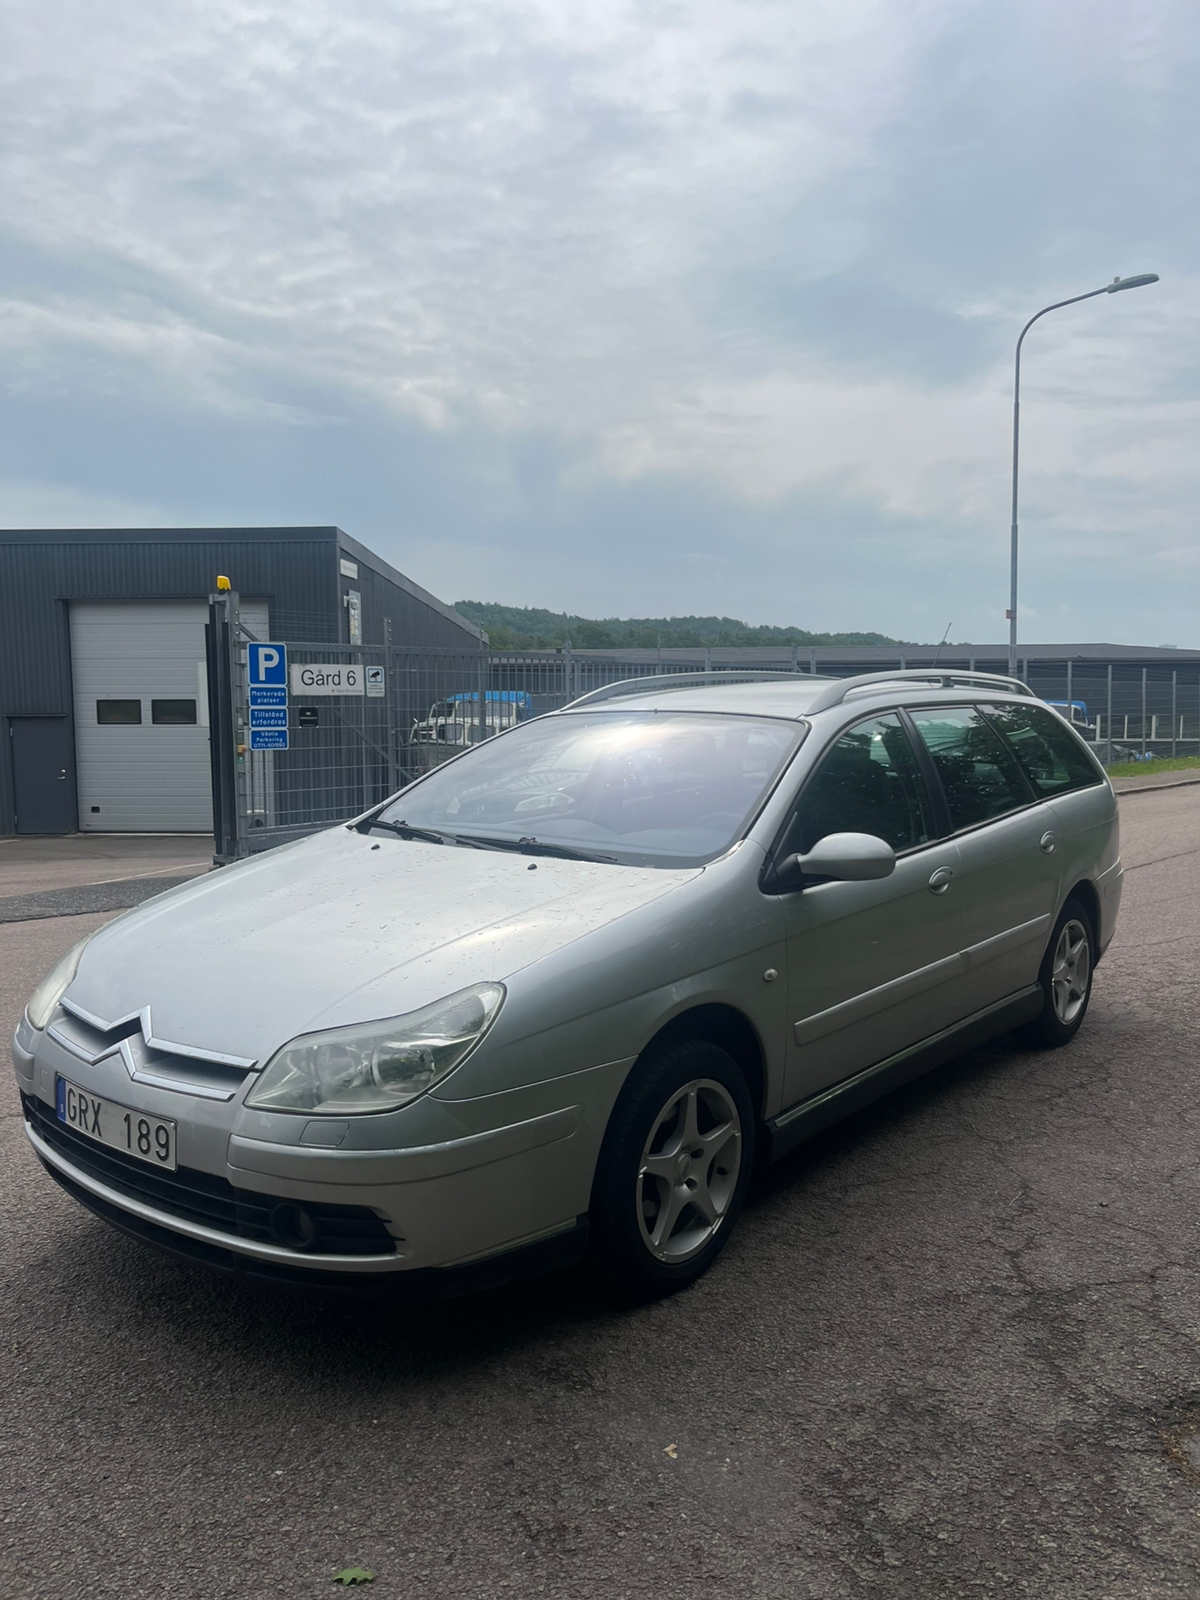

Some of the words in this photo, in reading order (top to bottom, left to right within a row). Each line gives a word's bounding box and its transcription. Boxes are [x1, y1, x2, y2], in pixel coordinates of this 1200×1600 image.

[258, 647, 280, 681] P
[301, 669, 341, 687] Gård
[347, 670, 356, 686] 6
[67, 1087, 102, 1137] GRX
[123, 1113, 169, 1161] 189
